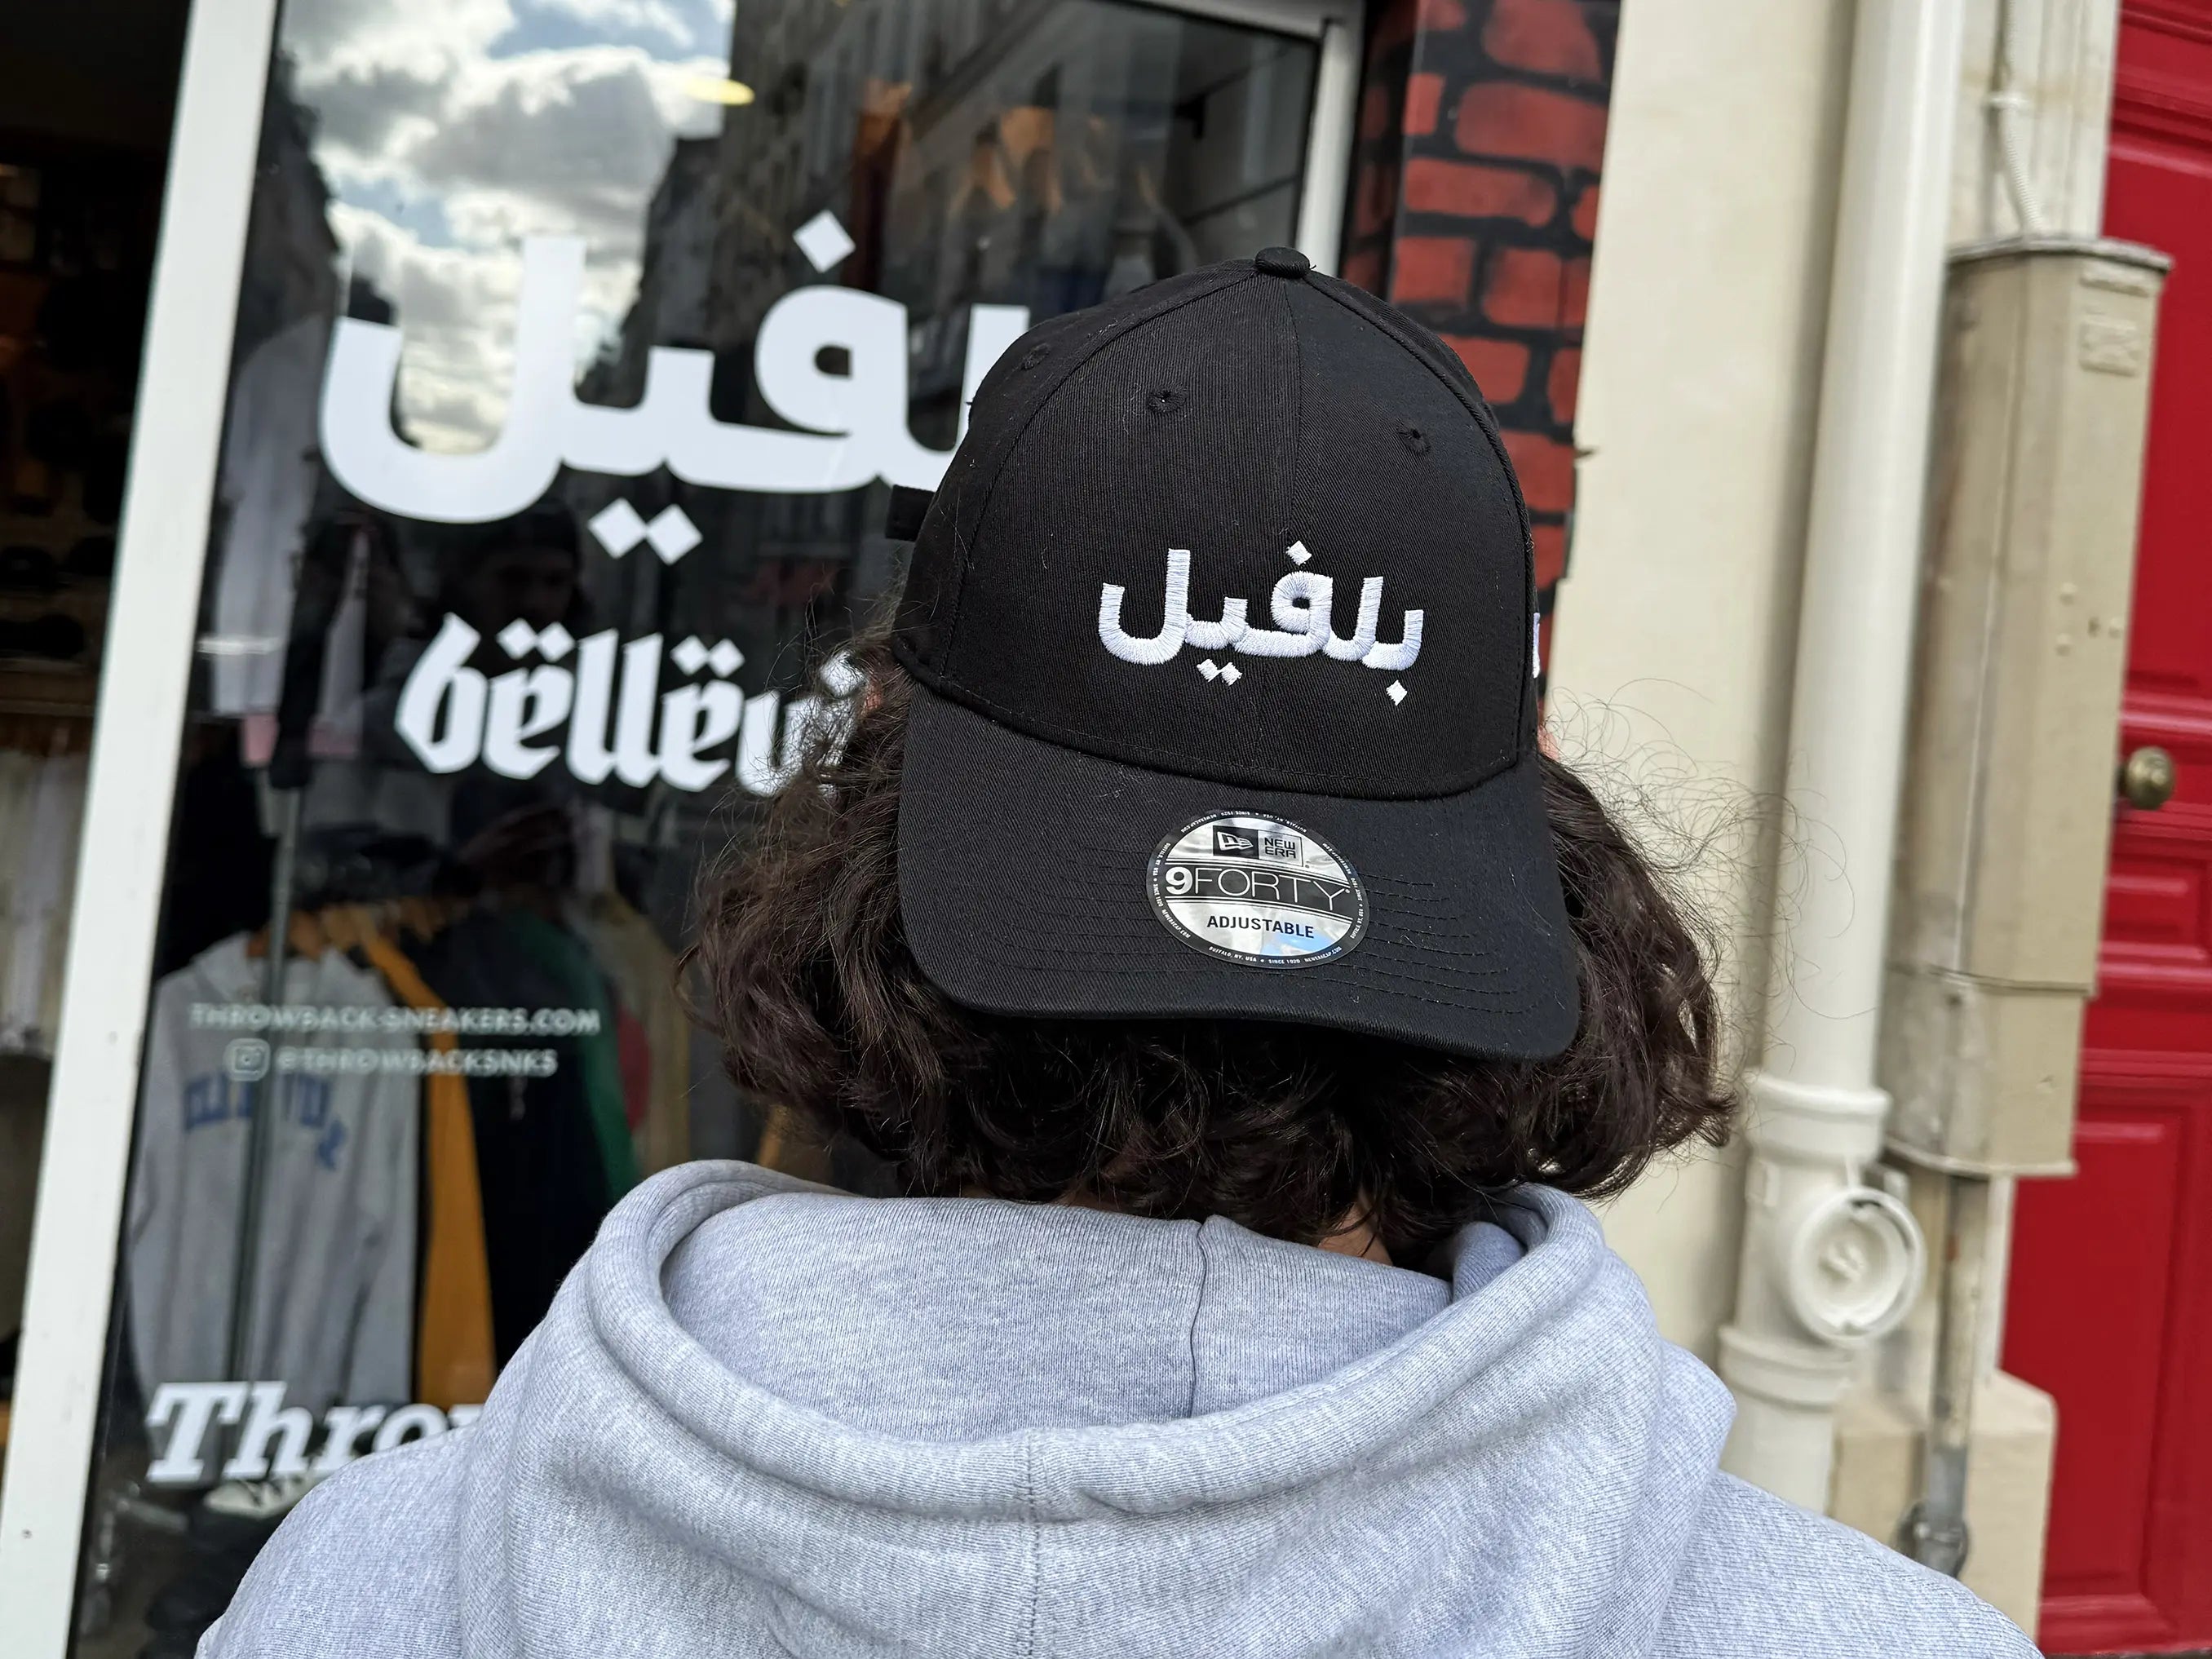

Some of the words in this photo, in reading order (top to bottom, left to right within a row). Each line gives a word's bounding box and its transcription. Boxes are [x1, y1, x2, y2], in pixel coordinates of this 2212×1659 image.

[1099, 540, 1424, 706] بلفيل
[1264, 837, 1296, 850] NEW
[1264, 847, 1296, 859] ERA
[1165, 866, 1347, 911] 9FORTY
[1206, 915, 1314, 939] ADJUSTABLE
[145, 1380, 487, 1483] Thro
